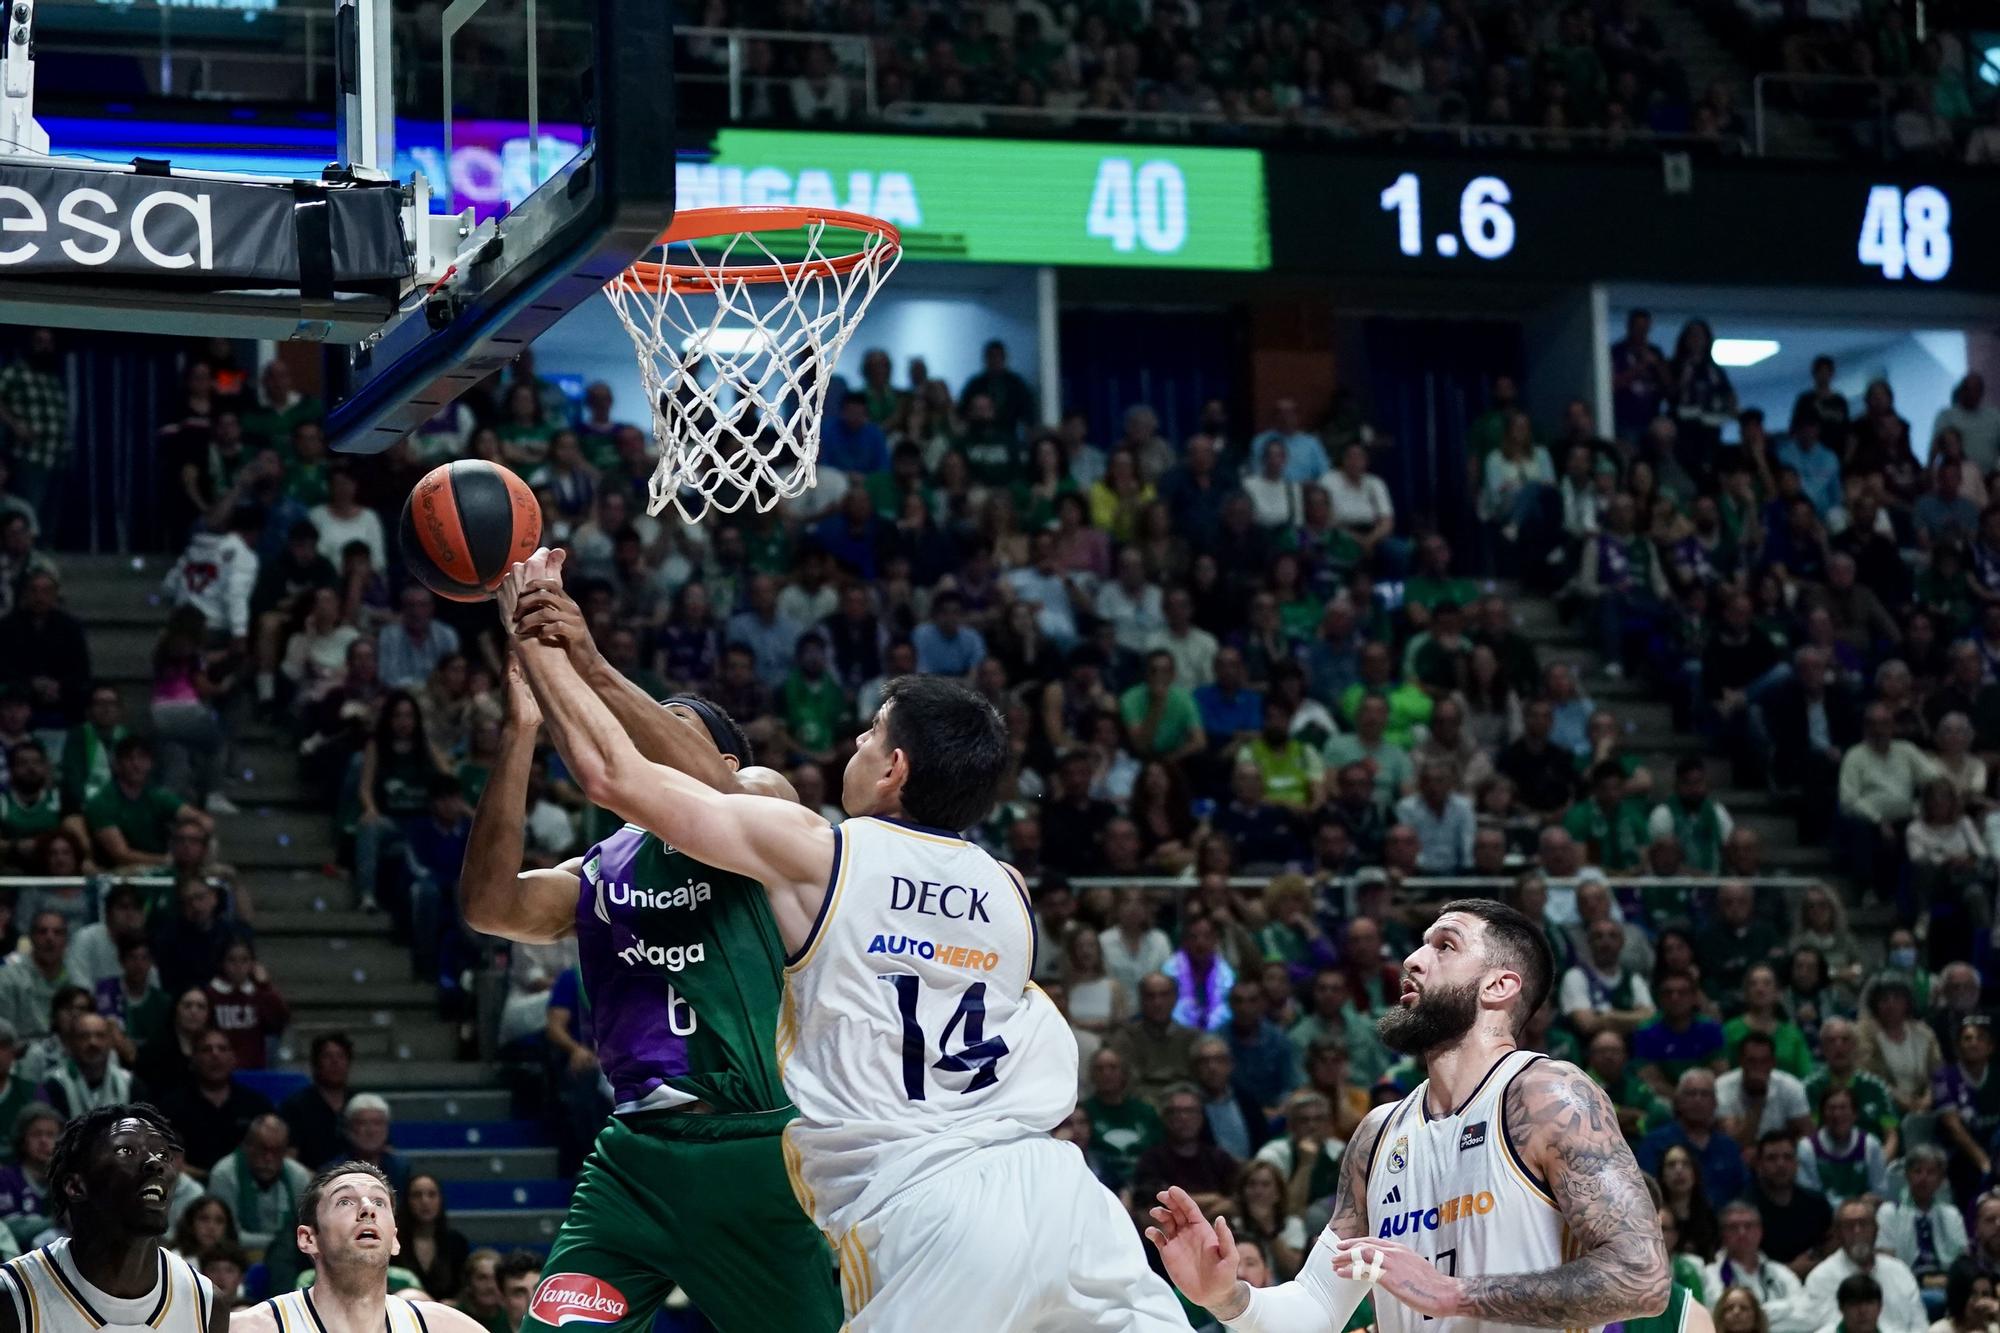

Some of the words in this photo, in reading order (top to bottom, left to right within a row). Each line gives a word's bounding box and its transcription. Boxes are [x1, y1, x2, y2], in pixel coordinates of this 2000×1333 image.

[1087, 158, 1187, 254] 40
[1380, 173, 1516, 260] 1.6
[1858, 185, 1952, 281] 48
[608, 878, 712, 911] Unicaja
[890, 876, 991, 923] DECK
[867, 935, 999, 972] AUTOHERO
[877, 973, 1010, 1102] 14
[1378, 1191, 1495, 1239] AUTOHERO
